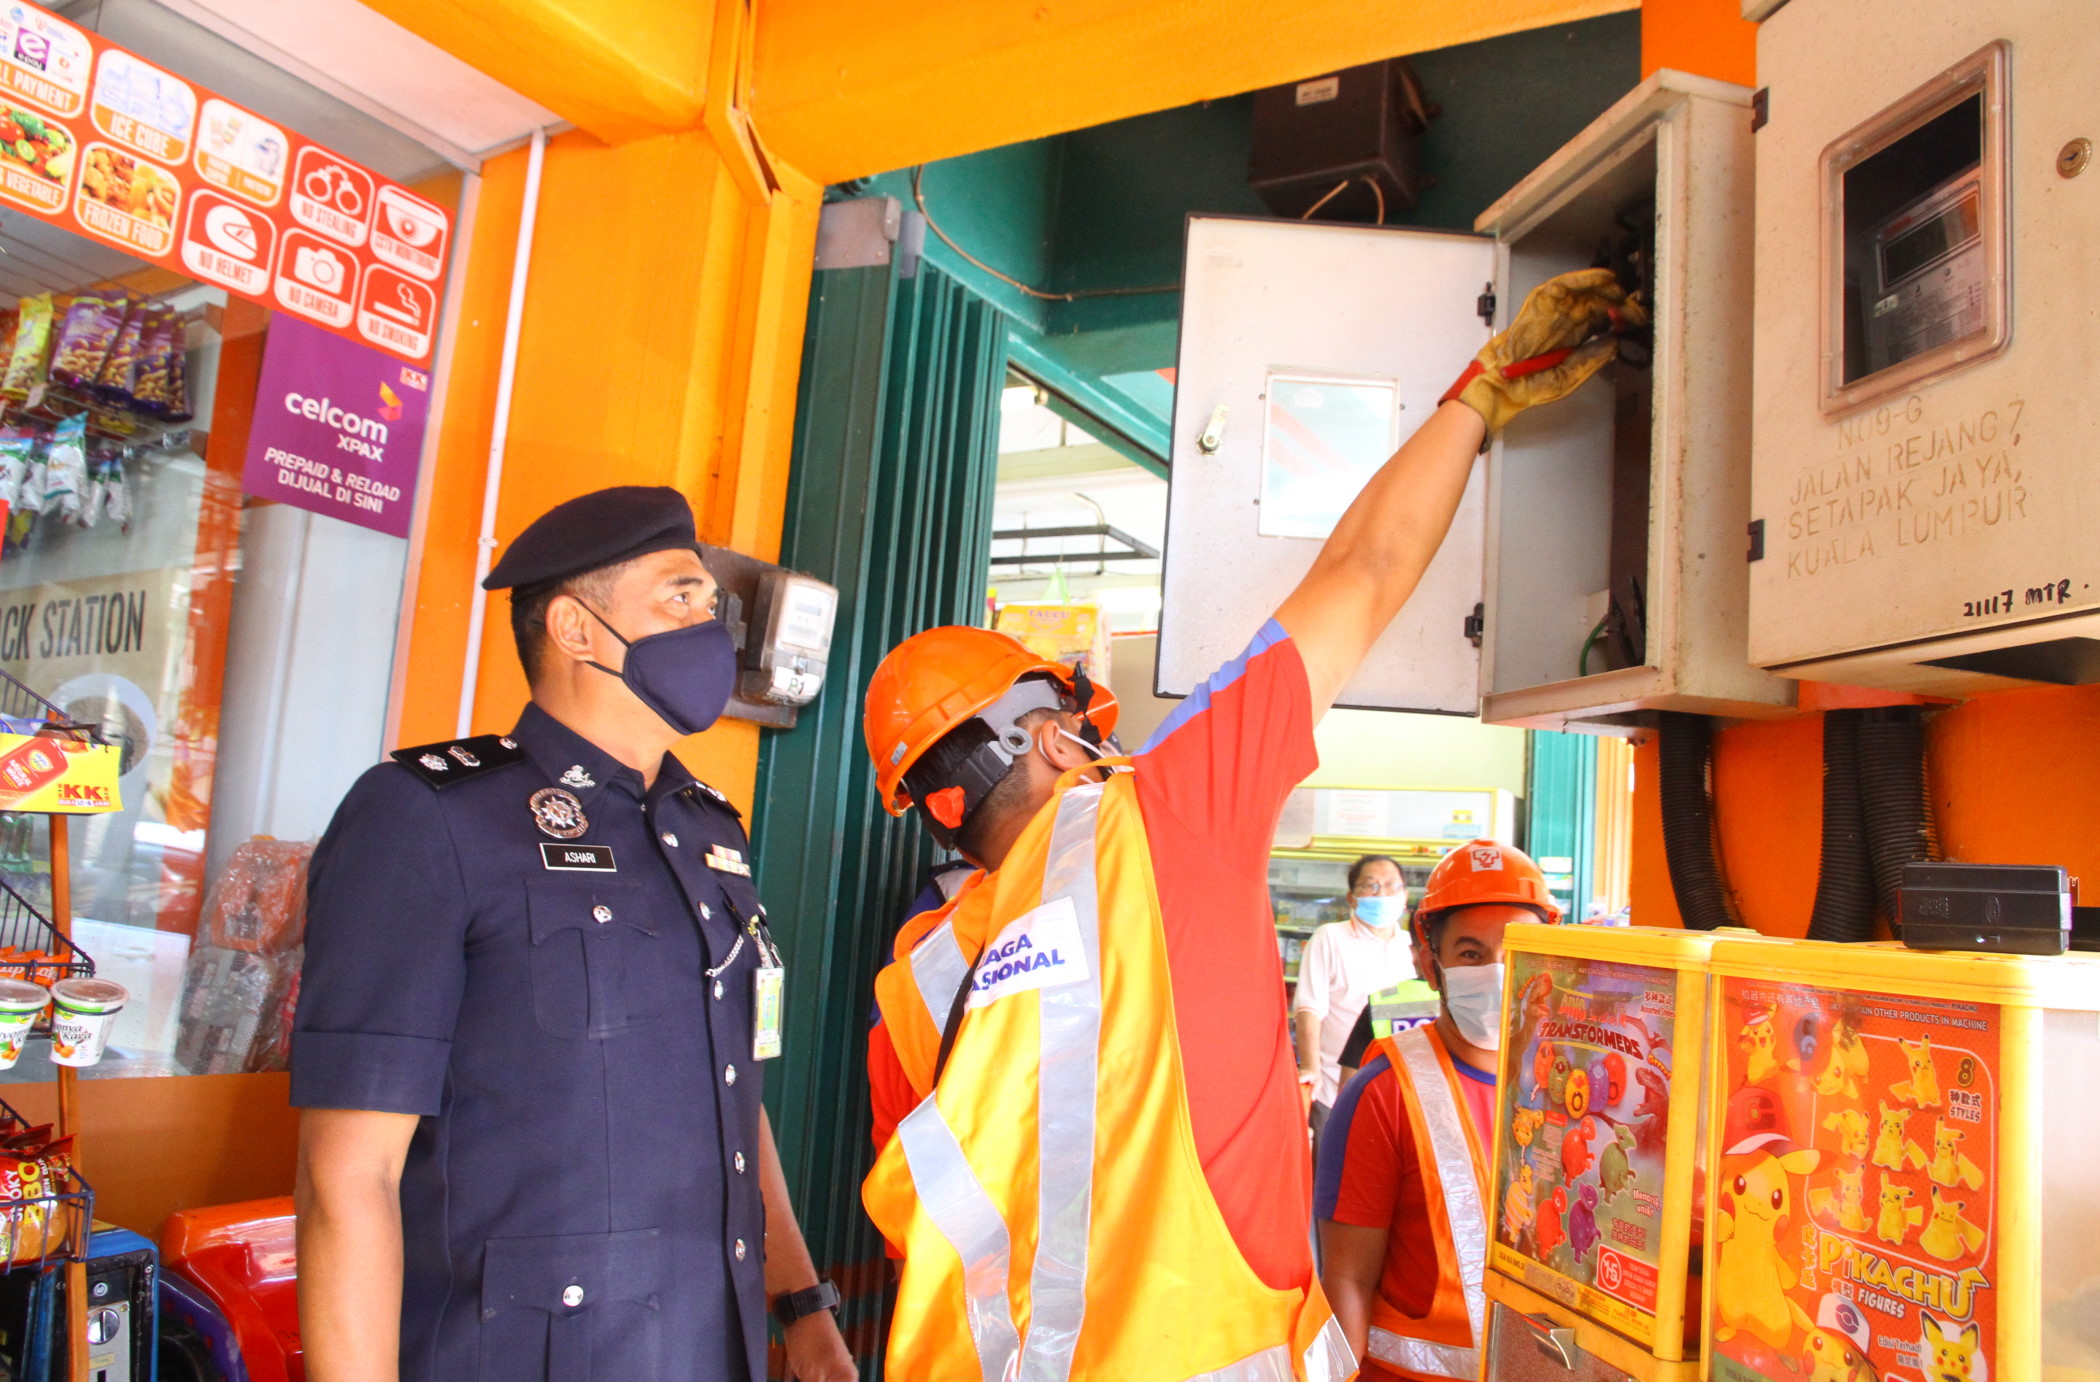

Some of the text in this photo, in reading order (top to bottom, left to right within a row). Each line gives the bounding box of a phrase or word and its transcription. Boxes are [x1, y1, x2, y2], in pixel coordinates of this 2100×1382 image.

[14, 67, 72, 111] PAYMENT
[111, 113, 170, 156] ICE CUBE
[6, 172, 61, 206] VEGETABLE
[84, 201, 163, 250] FROZEN FOOD
[302, 200, 356, 238] NO STEALING
[200, 250, 253, 285] NO HELMET
[375, 233, 436, 273] CCTV MONITORING
[289, 286, 338, 320] NO CAMERA
[369, 317, 418, 351] NO SMOKING
[285, 393, 388, 445] celcom
[336, 434, 384, 462] XPAX
[1790, 455, 1872, 506] JALAN
[1888, 410, 1998, 474] REJANG
[264, 447, 400, 501] PREPAID & RELOAD
[278, 469, 383, 514] DIJUAL DI SINI
[1788, 450, 2022, 540] SETAPAK JAYA,
[1788, 486, 2027, 578] KUALA LUMPUR
[1963, 589, 2014, 617] 21117
[40, 590, 146, 659] STATION
[63, 783, 103, 800] KK
[564, 851, 597, 864] ASHARI
[972, 949, 1066, 991] ASIONAL
[1875, 1008, 1899, 1019] OTHER
[1900, 1010, 1940, 1025] PRODUCTS
[1942, 1016, 1950, 1026] IN
[1951, 1018, 1988, 1032] MACHINE
[1539, 1022, 1643, 1060] TRANSFORMERS
[1957, 1056, 1974, 1088] 8
[1950, 1106, 1981, 1122] STYLES
[18, 1161, 44, 1225] BBQ
[1857, 1288, 1906, 1319] FIGURES
[1878, 1335, 1895, 1349] Edisi
